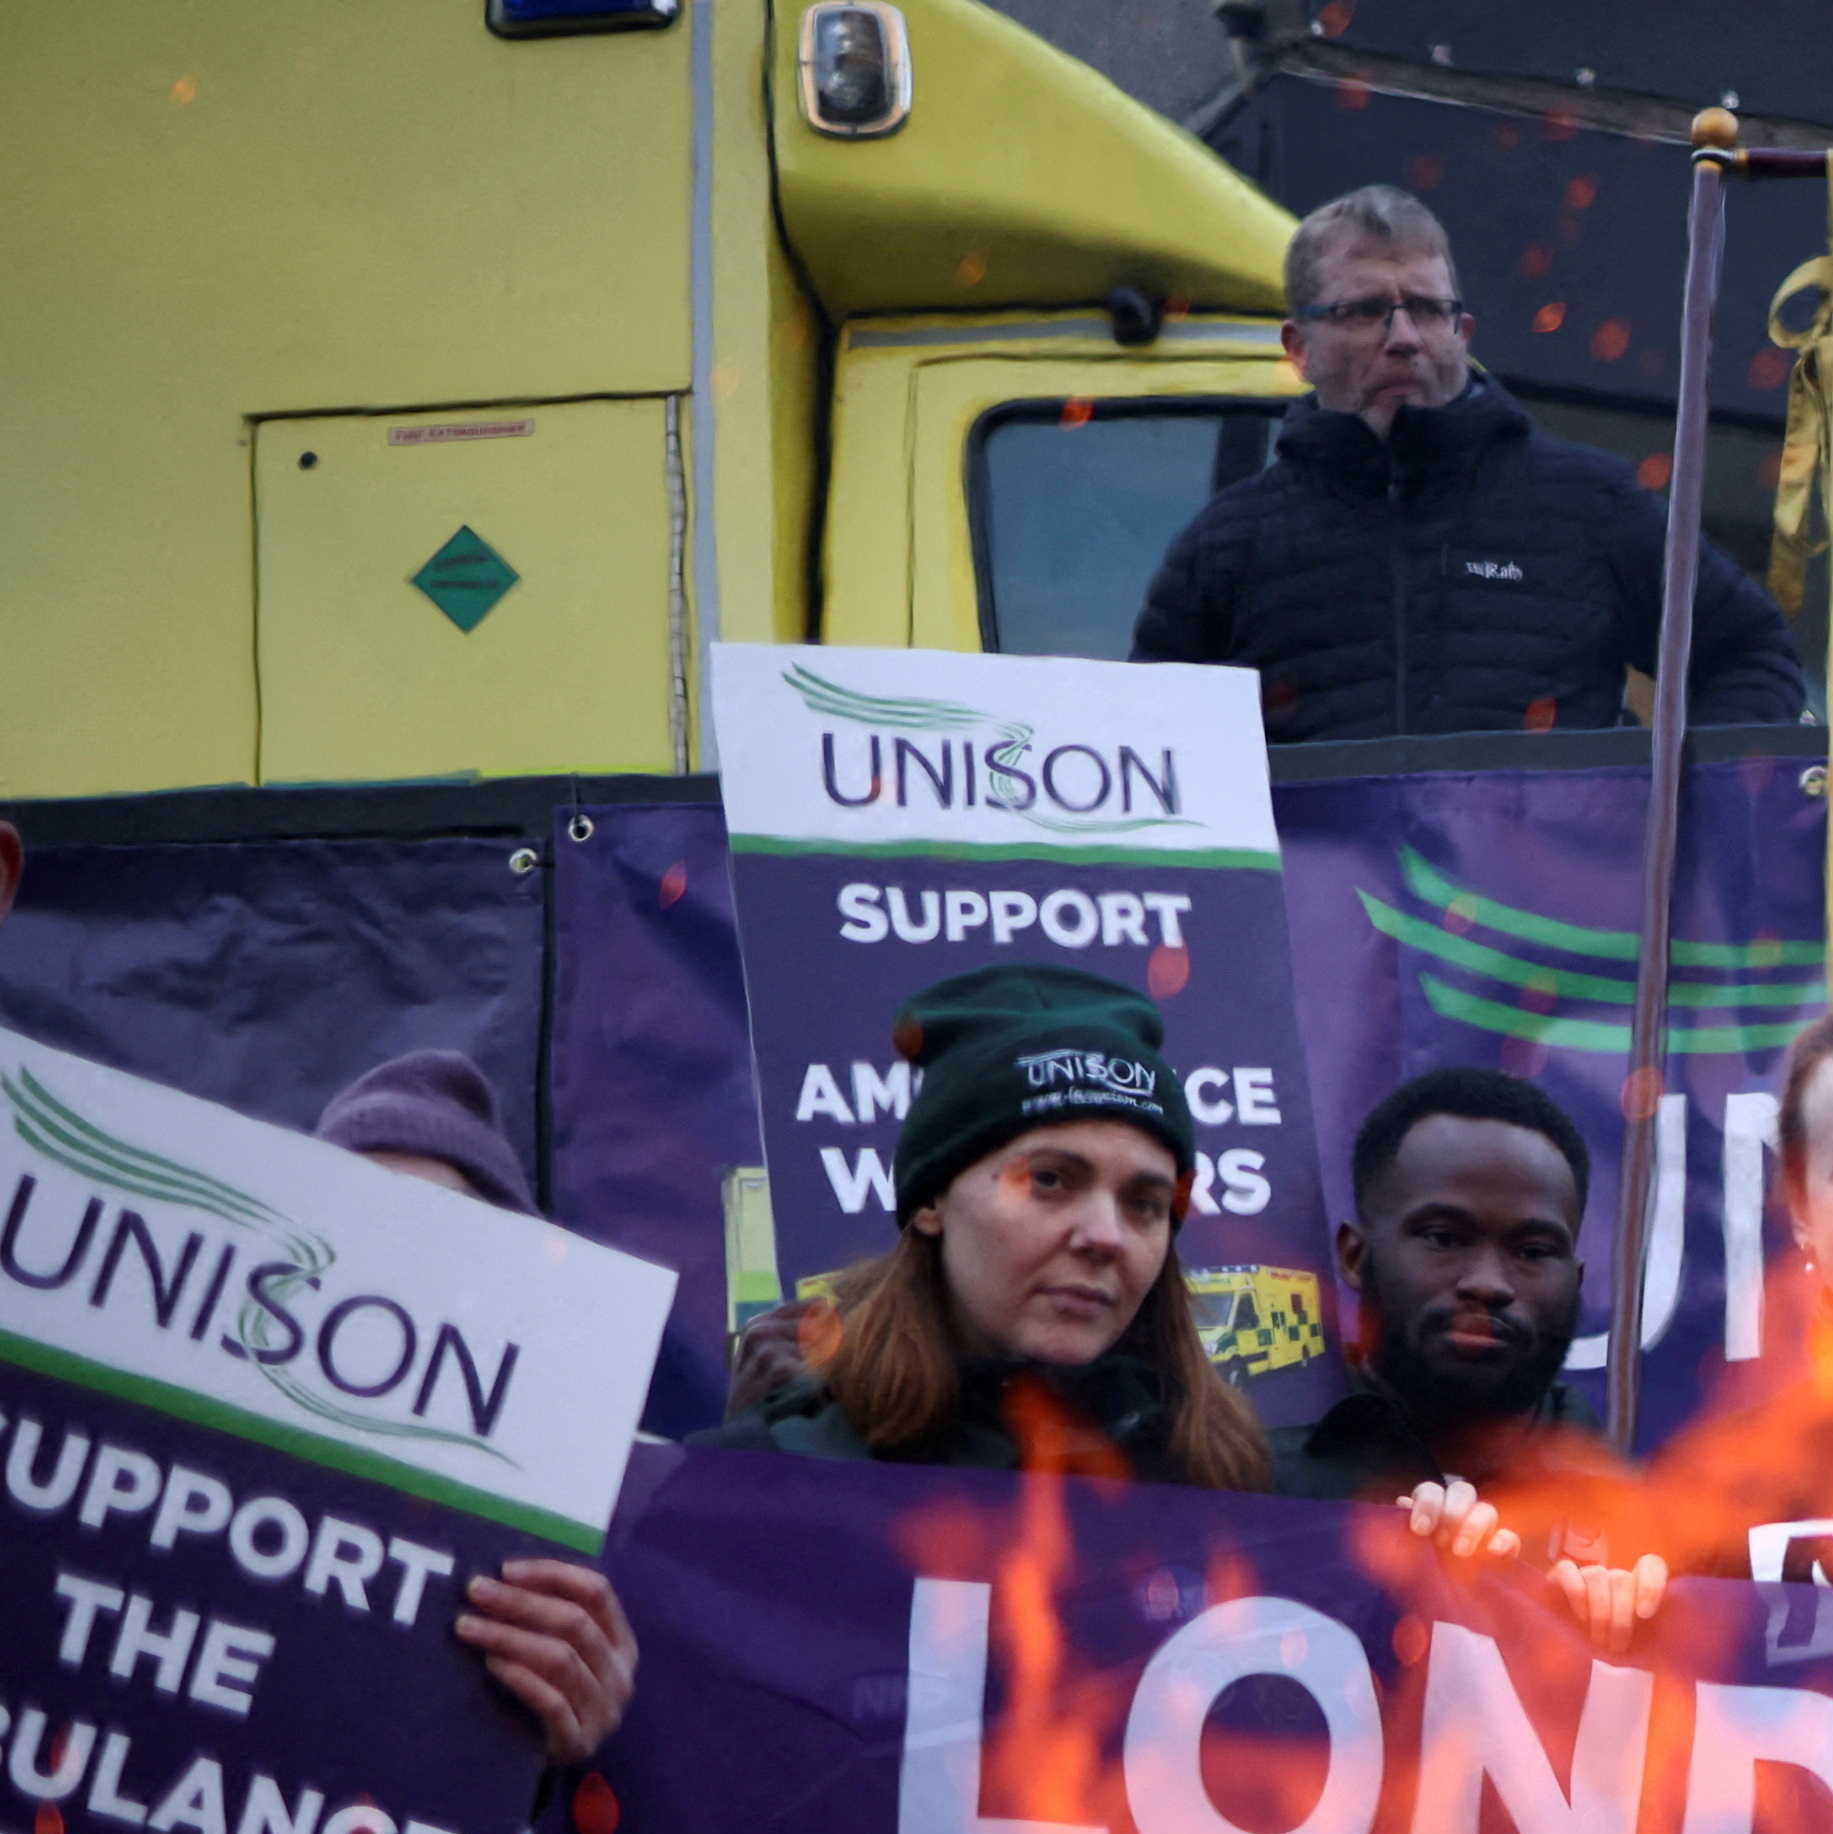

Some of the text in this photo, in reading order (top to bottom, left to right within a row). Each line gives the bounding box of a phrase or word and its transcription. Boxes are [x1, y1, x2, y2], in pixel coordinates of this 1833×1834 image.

[821, 732, 1182, 816] UNISON
[838, 883, 1191, 948] SUPPORT
[1028, 1052, 1156, 1092] UNISON
[0, 1173, 520, 1437] UNISON
[0, 1416, 454, 1628] UPPORT
[54, 1572, 276, 1716] THE
